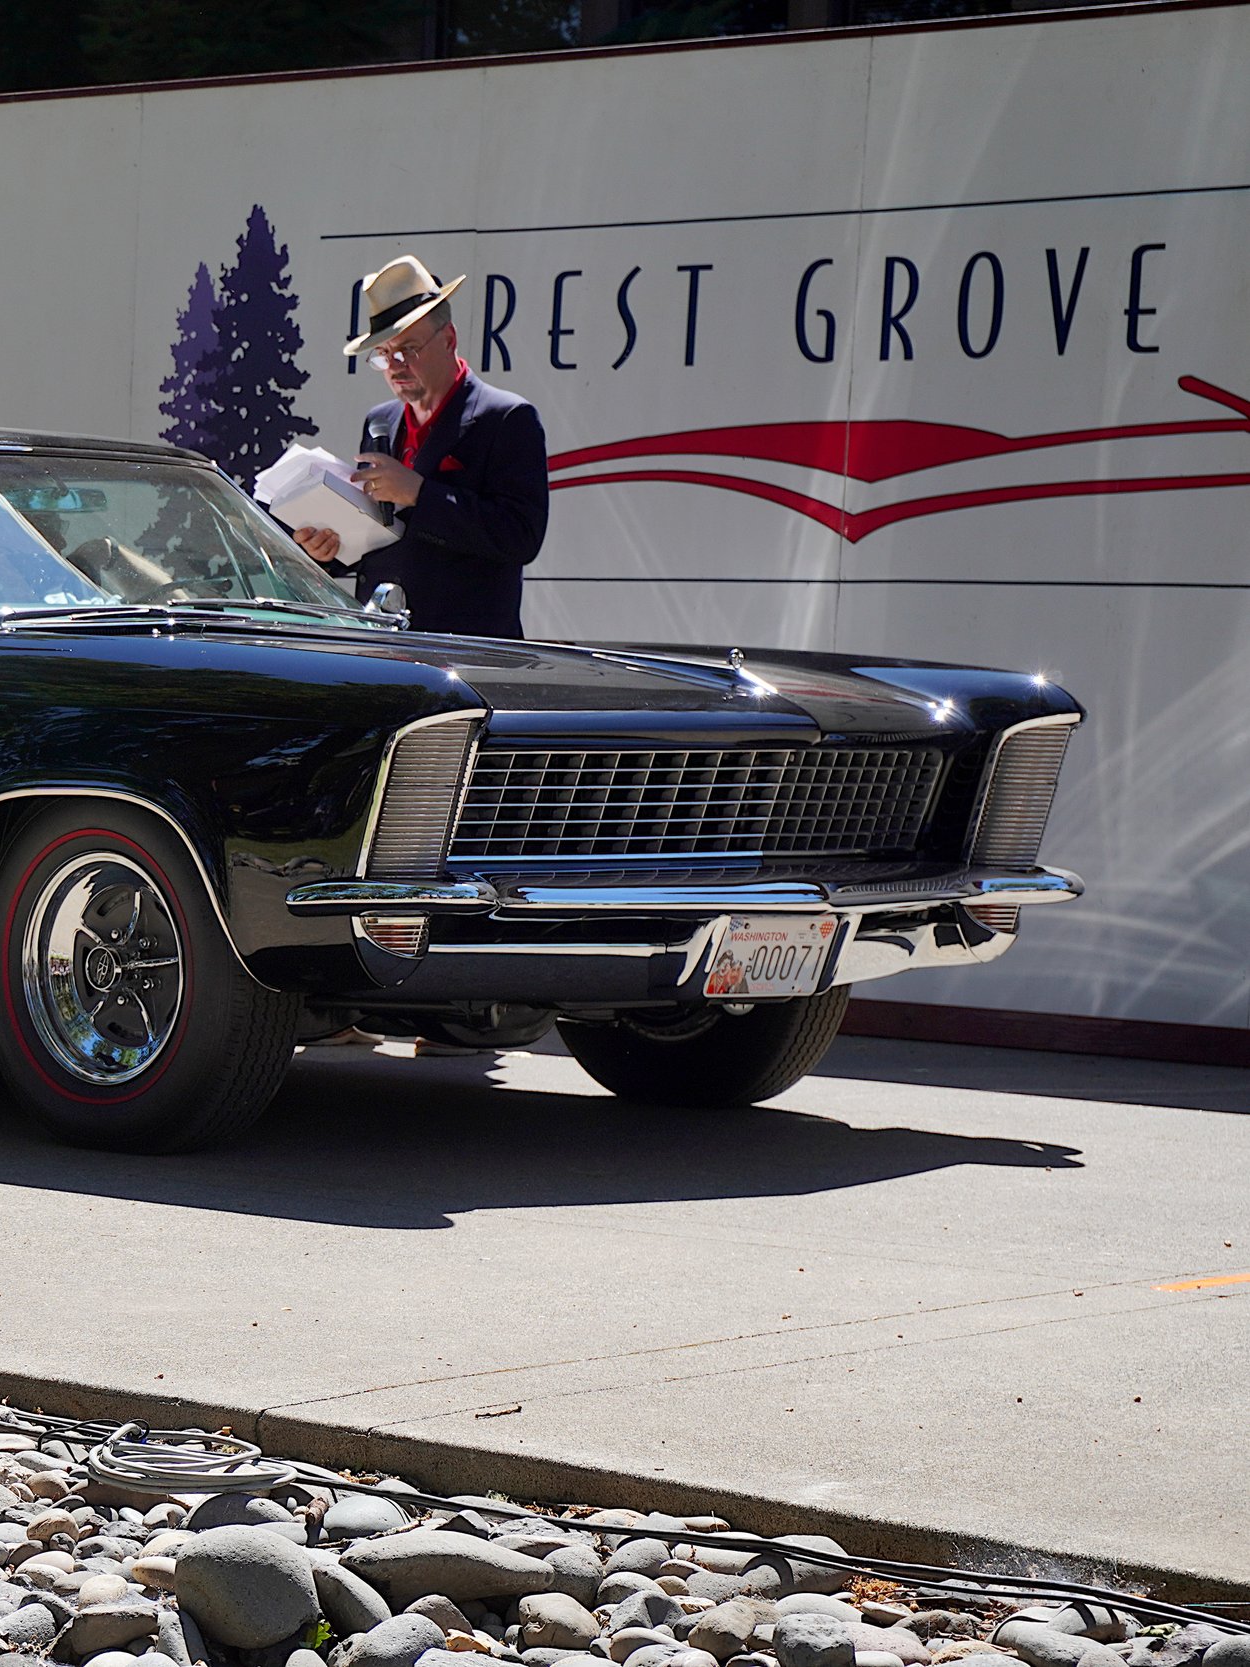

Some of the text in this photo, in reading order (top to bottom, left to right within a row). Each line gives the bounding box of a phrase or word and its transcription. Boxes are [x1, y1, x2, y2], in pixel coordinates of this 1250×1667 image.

[795, 243, 1166, 364] GROVE
[730, 931, 788, 942] WASHINGTON
[750, 945, 825, 981] 00071
